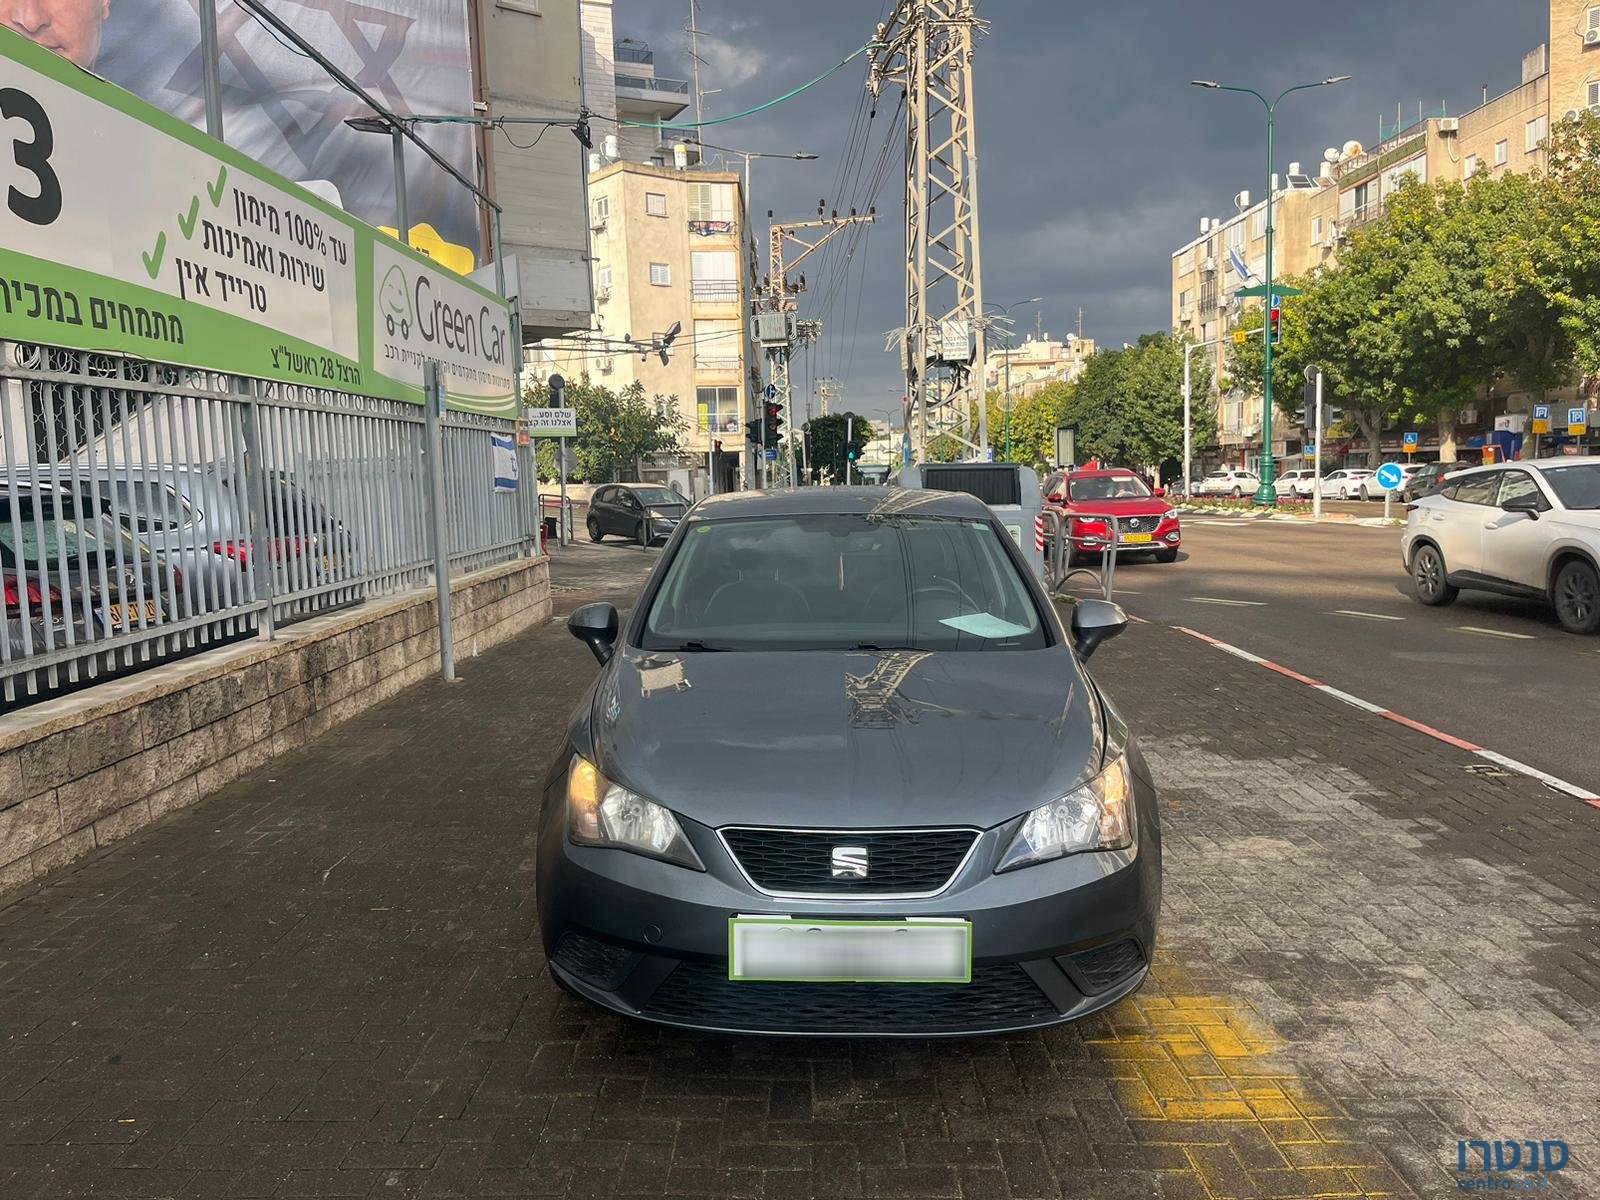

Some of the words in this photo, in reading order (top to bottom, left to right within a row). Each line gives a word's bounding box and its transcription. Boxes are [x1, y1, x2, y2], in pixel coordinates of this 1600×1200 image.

[233, 187, 281, 236] מימון
[202, 219, 275, 274] ואמינות
[284, 210, 326, 256] 100%
[329, 235, 347, 265] עד
[175, 257, 211, 300] אין
[215, 270, 267, 313] טרייד
[279, 250, 325, 292] שירות
[89, 296, 184, 345] מתמחים
[415, 275, 477, 357] Green
[479, 305, 506, 366] Car
[270, 345, 319, 377] ראשל"צ
[320, 356, 335, 380] 28
[335, 358, 361, 386] הרצל
[384, 343, 399, 361] רכב
[551, 418, 572, 427] אצלנו
[554, 410, 572, 419] שלם
